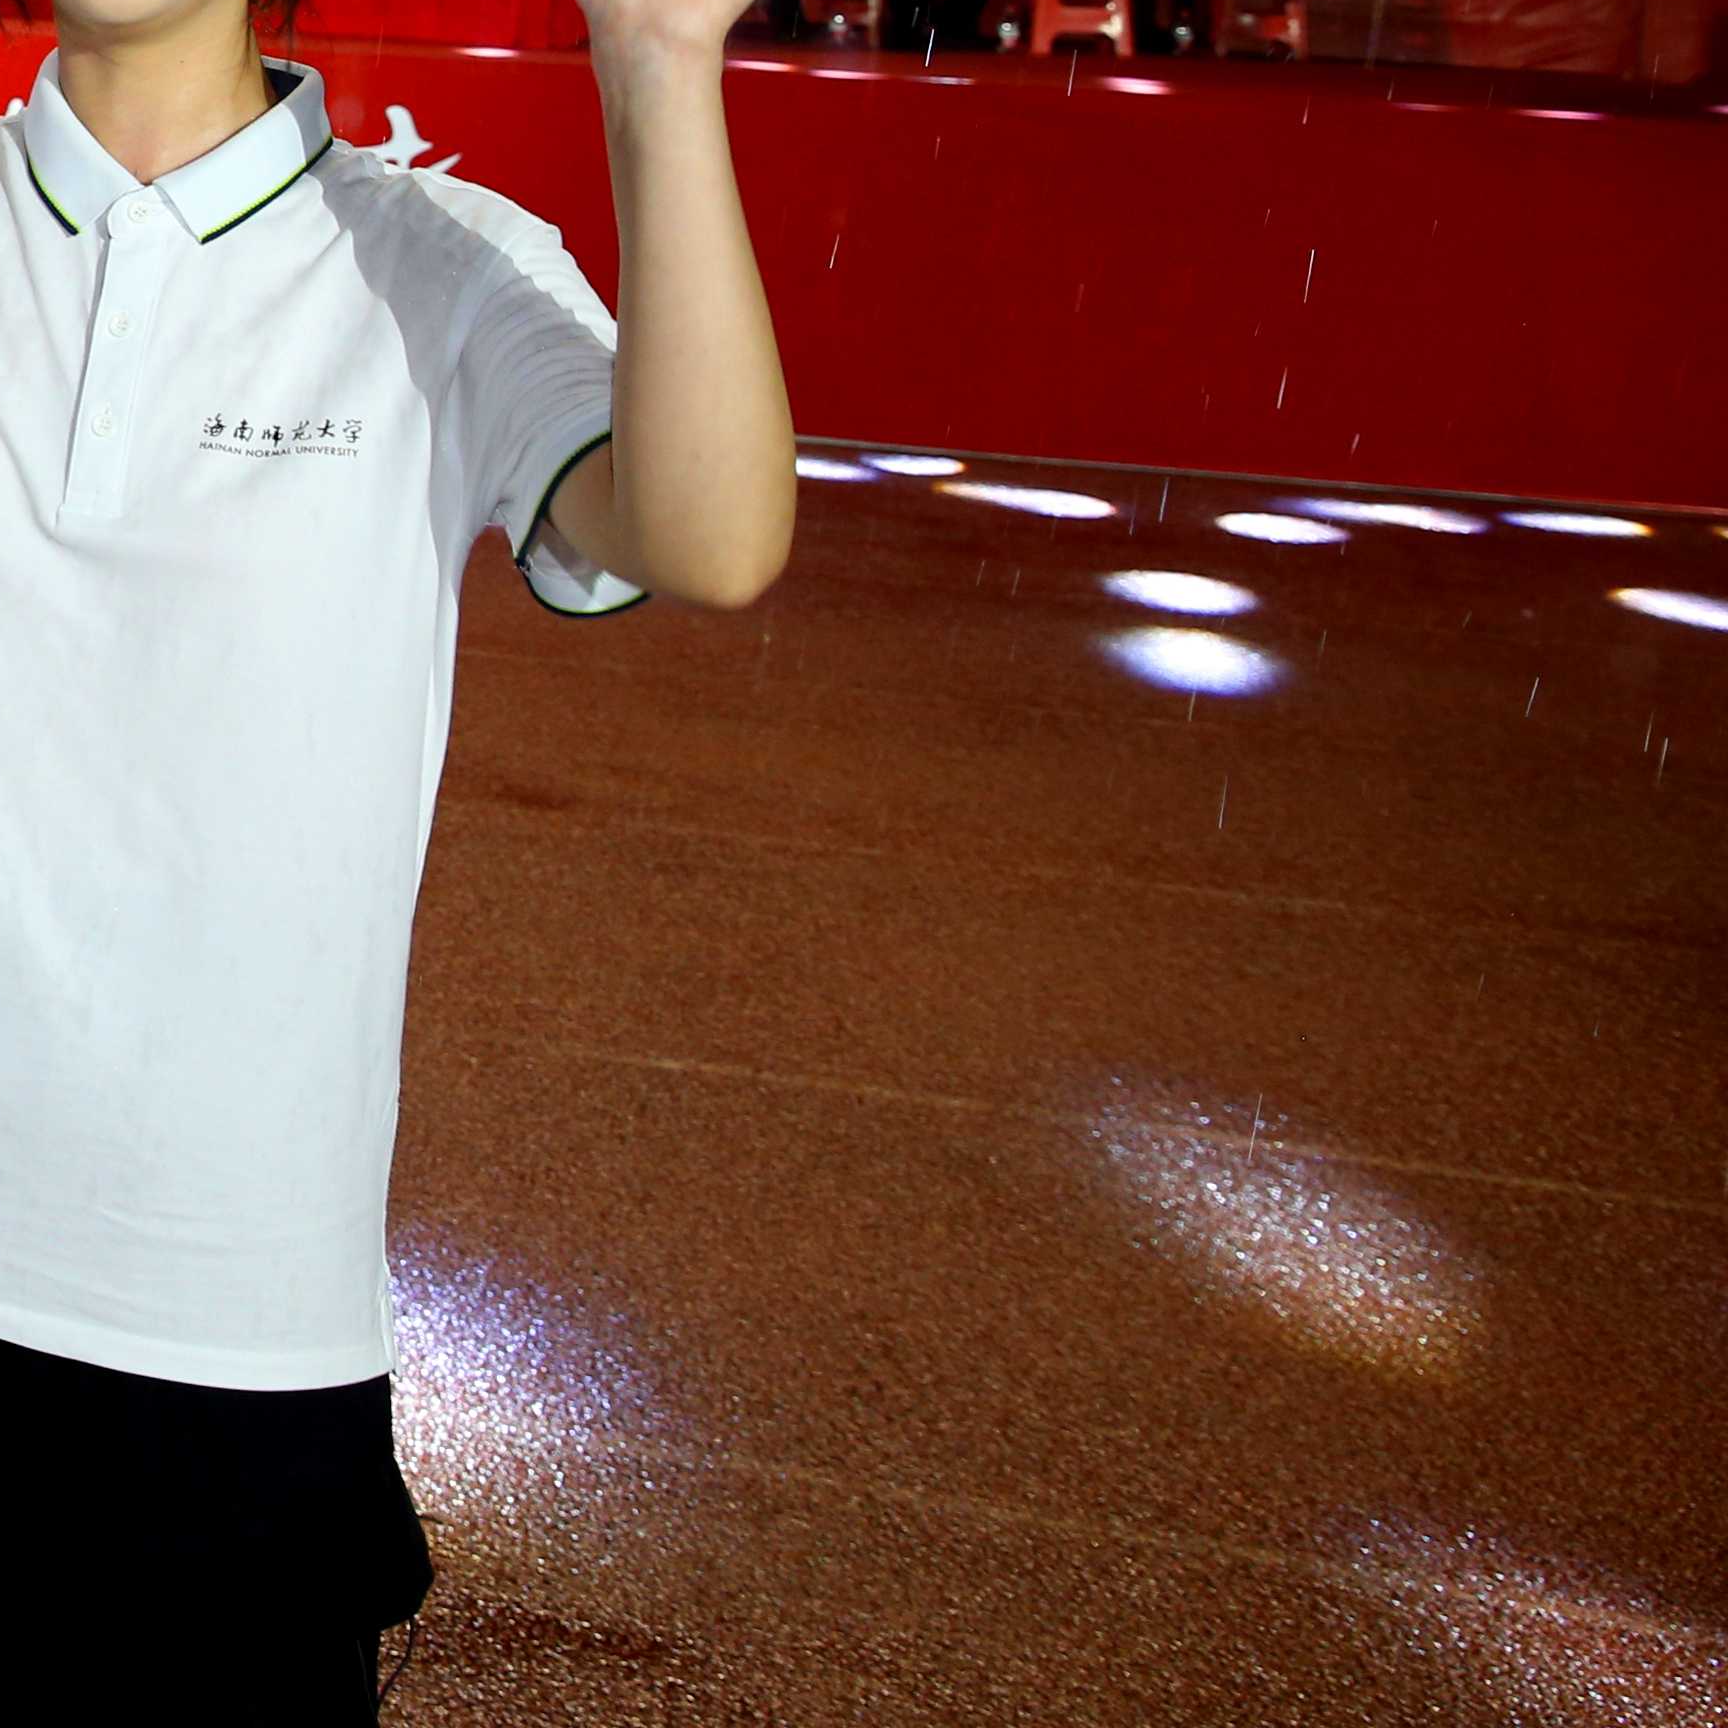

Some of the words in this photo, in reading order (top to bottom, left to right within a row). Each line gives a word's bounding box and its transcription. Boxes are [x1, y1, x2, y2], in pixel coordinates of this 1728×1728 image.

[199, 440, 243, 456] HAINAN
[245, 446, 293, 459] NORMAL
[295, 444, 360, 460] UNIVERSITY
